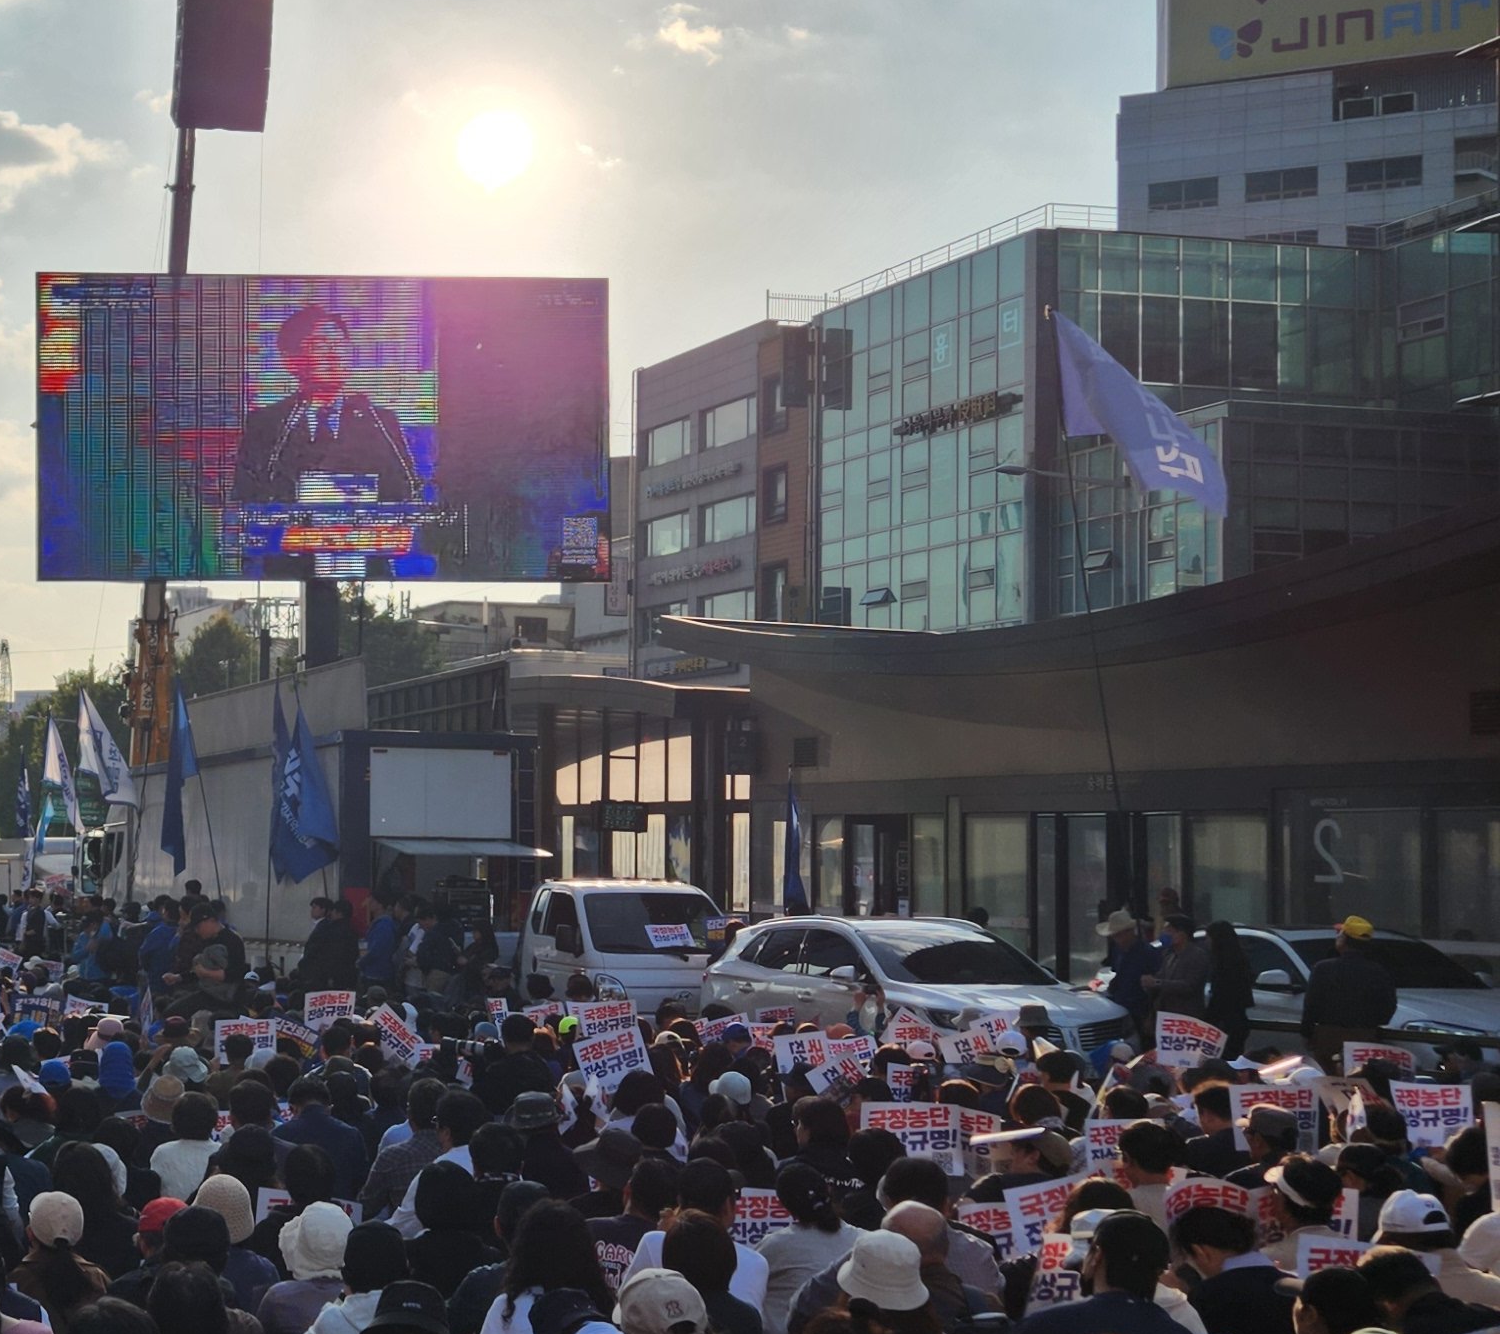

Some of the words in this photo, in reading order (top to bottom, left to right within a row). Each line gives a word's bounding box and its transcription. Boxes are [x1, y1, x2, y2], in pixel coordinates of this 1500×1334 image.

[309, 992, 350, 1006] 국정농단
[307, 1005, 353, 1021] 진상규명!
[583, 1002, 632, 1020] 국정농단
[220, 1020, 270, 1036] 국정농단
[585, 1015, 636, 1035] 진상규명!
[1161, 1018, 1223, 1044] 국정농단
[578, 1031, 635, 1064] 국정농단
[1160, 1035, 1222, 1058] 진상규명!
[583, 1046, 645, 1080] 진상규명!
[867, 1106, 951, 1130] 국정농단
[900, 1129, 958, 1151] 규명!
